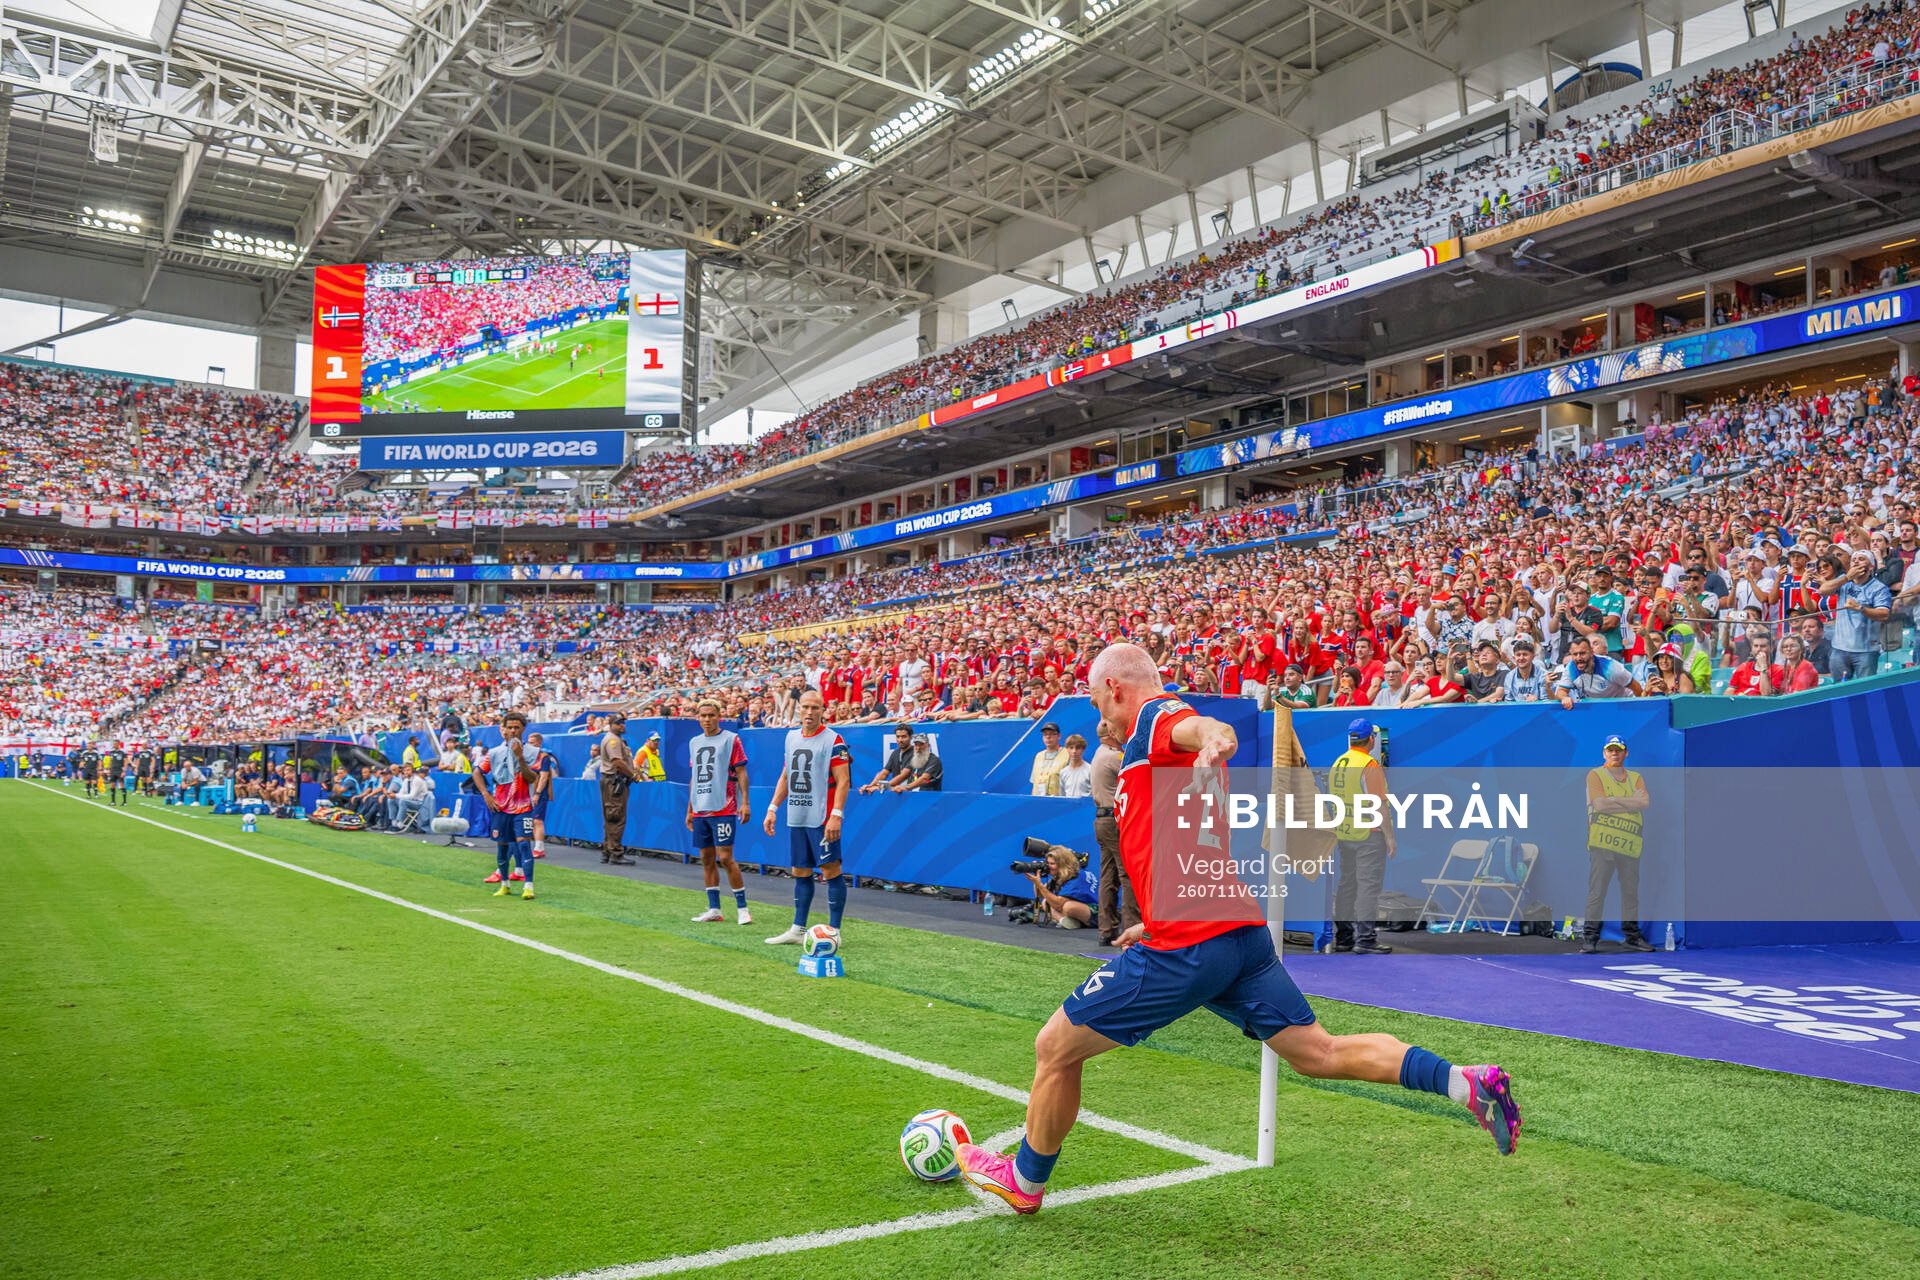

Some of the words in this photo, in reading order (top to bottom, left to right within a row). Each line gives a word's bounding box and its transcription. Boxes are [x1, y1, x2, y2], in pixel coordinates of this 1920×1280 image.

[1649, 79, 1672, 98] 347
[1305, 278, 1349, 300] ENGLAND
[1807, 296, 1901, 336] MIAMI
[1159, 335, 1168, 348] 1
[326, 356, 348, 379] 1
[643, 348, 663, 369] 1
[1101, 353, 1111, 367] 1
[466, 409, 515, 420] Hisense
[1384, 400, 1453, 426] #FIFAWorldCup
[384, 445, 423, 461] FIFA
[424, 444, 491, 460] WORLD
[493, 442, 530, 458] CUP
[532, 440, 598, 458] 2026
[1116, 463, 1156, 486] MIAMI
[895, 521, 914, 535] FIFA
[913, 513, 942, 531] WORLD
[943, 509, 960, 525] CUP
[960, 501, 993, 521] 2026
[136, 561, 167, 572] FIFA
[167, 563, 216, 576] WORLD
[217, 566, 244, 579] CUP
[244, 569, 286, 580] 2026
[789, 799, 813, 807] 2026
[717, 823, 732, 837] 20
[1597, 813, 1640, 834] SECURITY
[1599, 832, 1634, 852] 10671
